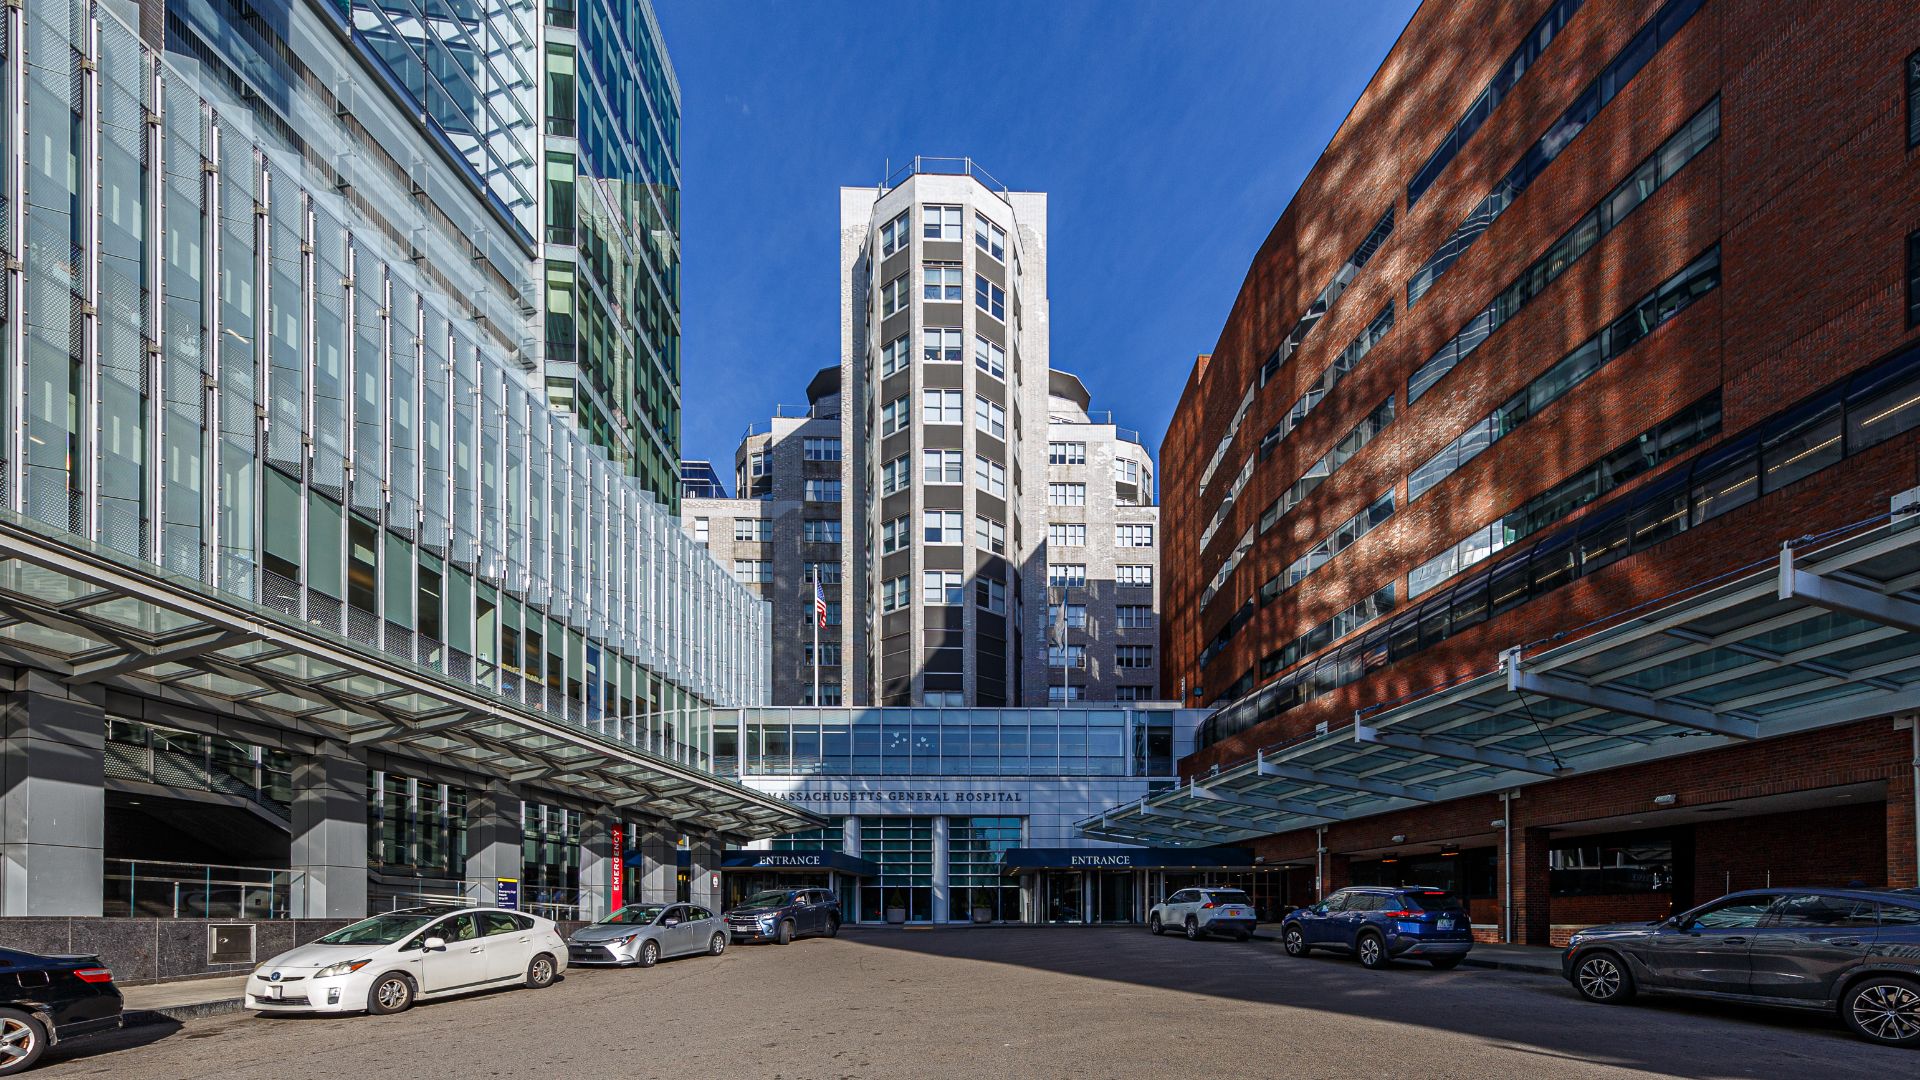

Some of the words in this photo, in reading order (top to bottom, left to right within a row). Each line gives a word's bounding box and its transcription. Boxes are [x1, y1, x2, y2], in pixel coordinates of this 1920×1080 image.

[888, 791, 950, 802] GENERAL
[955, 791, 1022, 802] HOSPITAL
[759, 855, 820, 865] ENTRANCE
[1071, 855, 1131, 865] ENTRANCE
